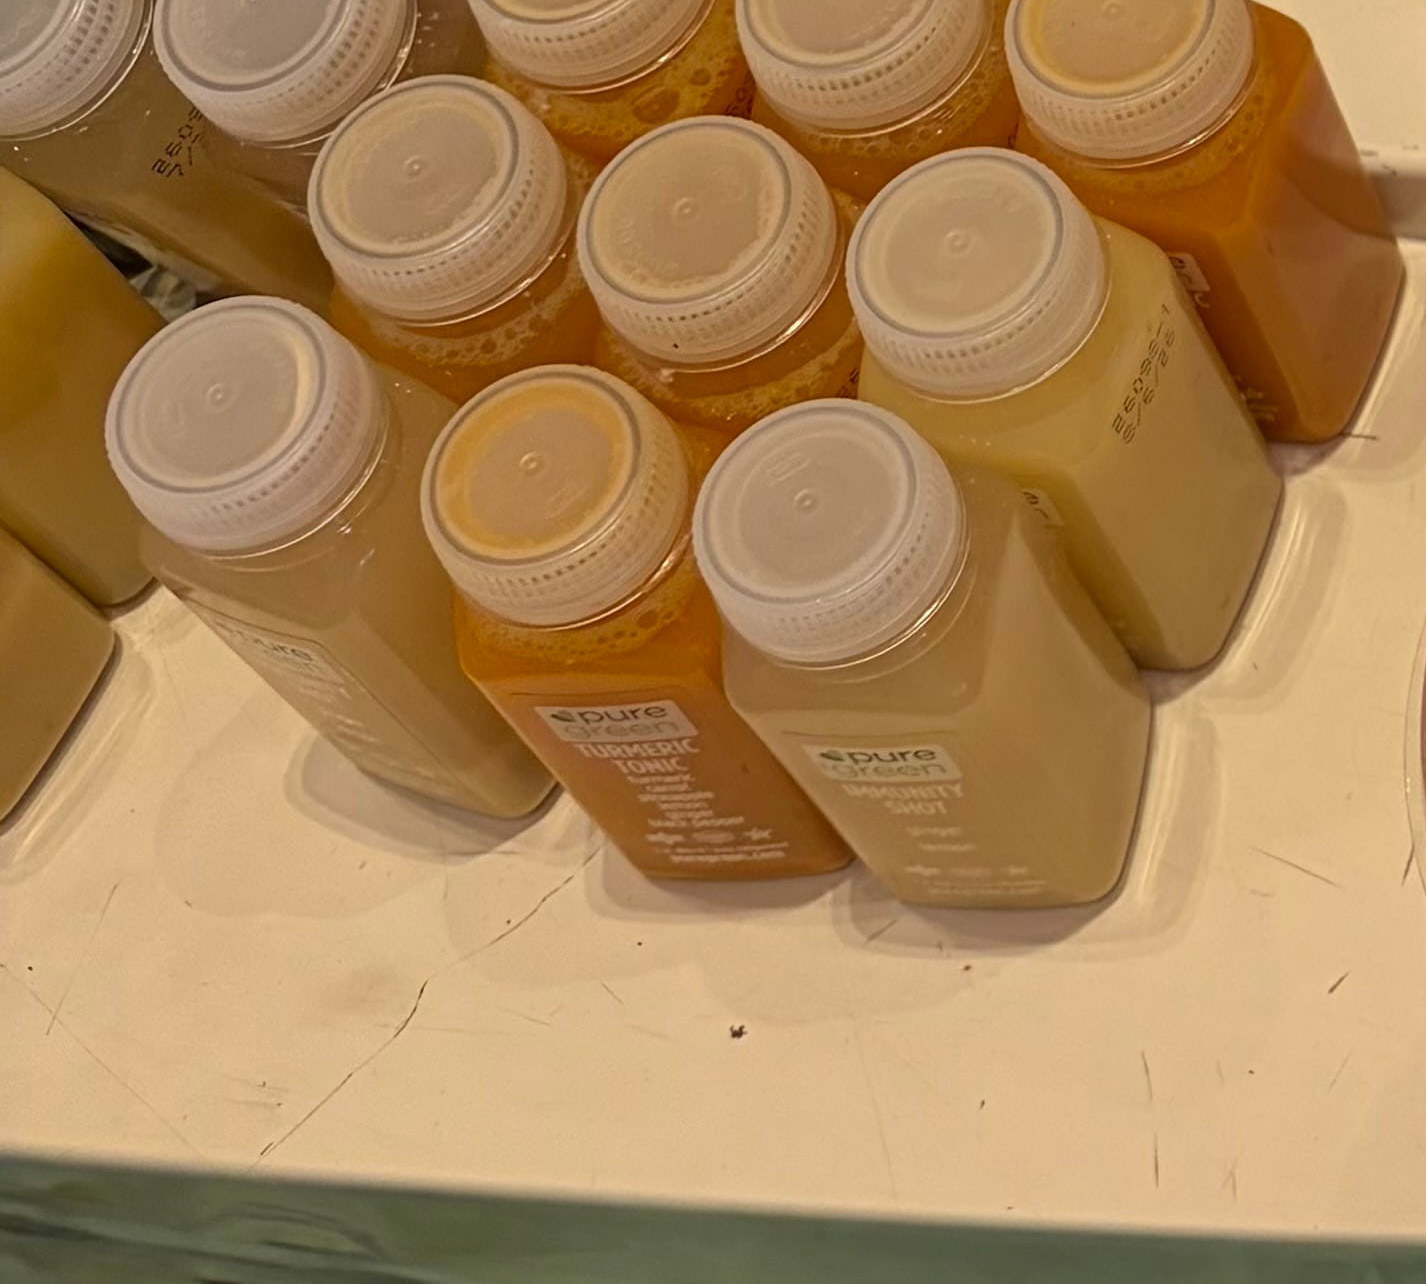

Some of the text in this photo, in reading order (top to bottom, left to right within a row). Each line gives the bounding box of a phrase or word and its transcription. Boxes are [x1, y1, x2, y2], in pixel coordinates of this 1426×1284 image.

[579, 705, 668, 725] pure
[564, 719, 680, 740] green
[573, 738, 700, 759] TURMERIC
[848, 748, 937, 765] pure
[612, 757, 689, 775] TONIC
[832, 763, 947, 779] green
[840, 781, 964, 800] IMMUNITY
[883, 800, 948, 816] SHOT
